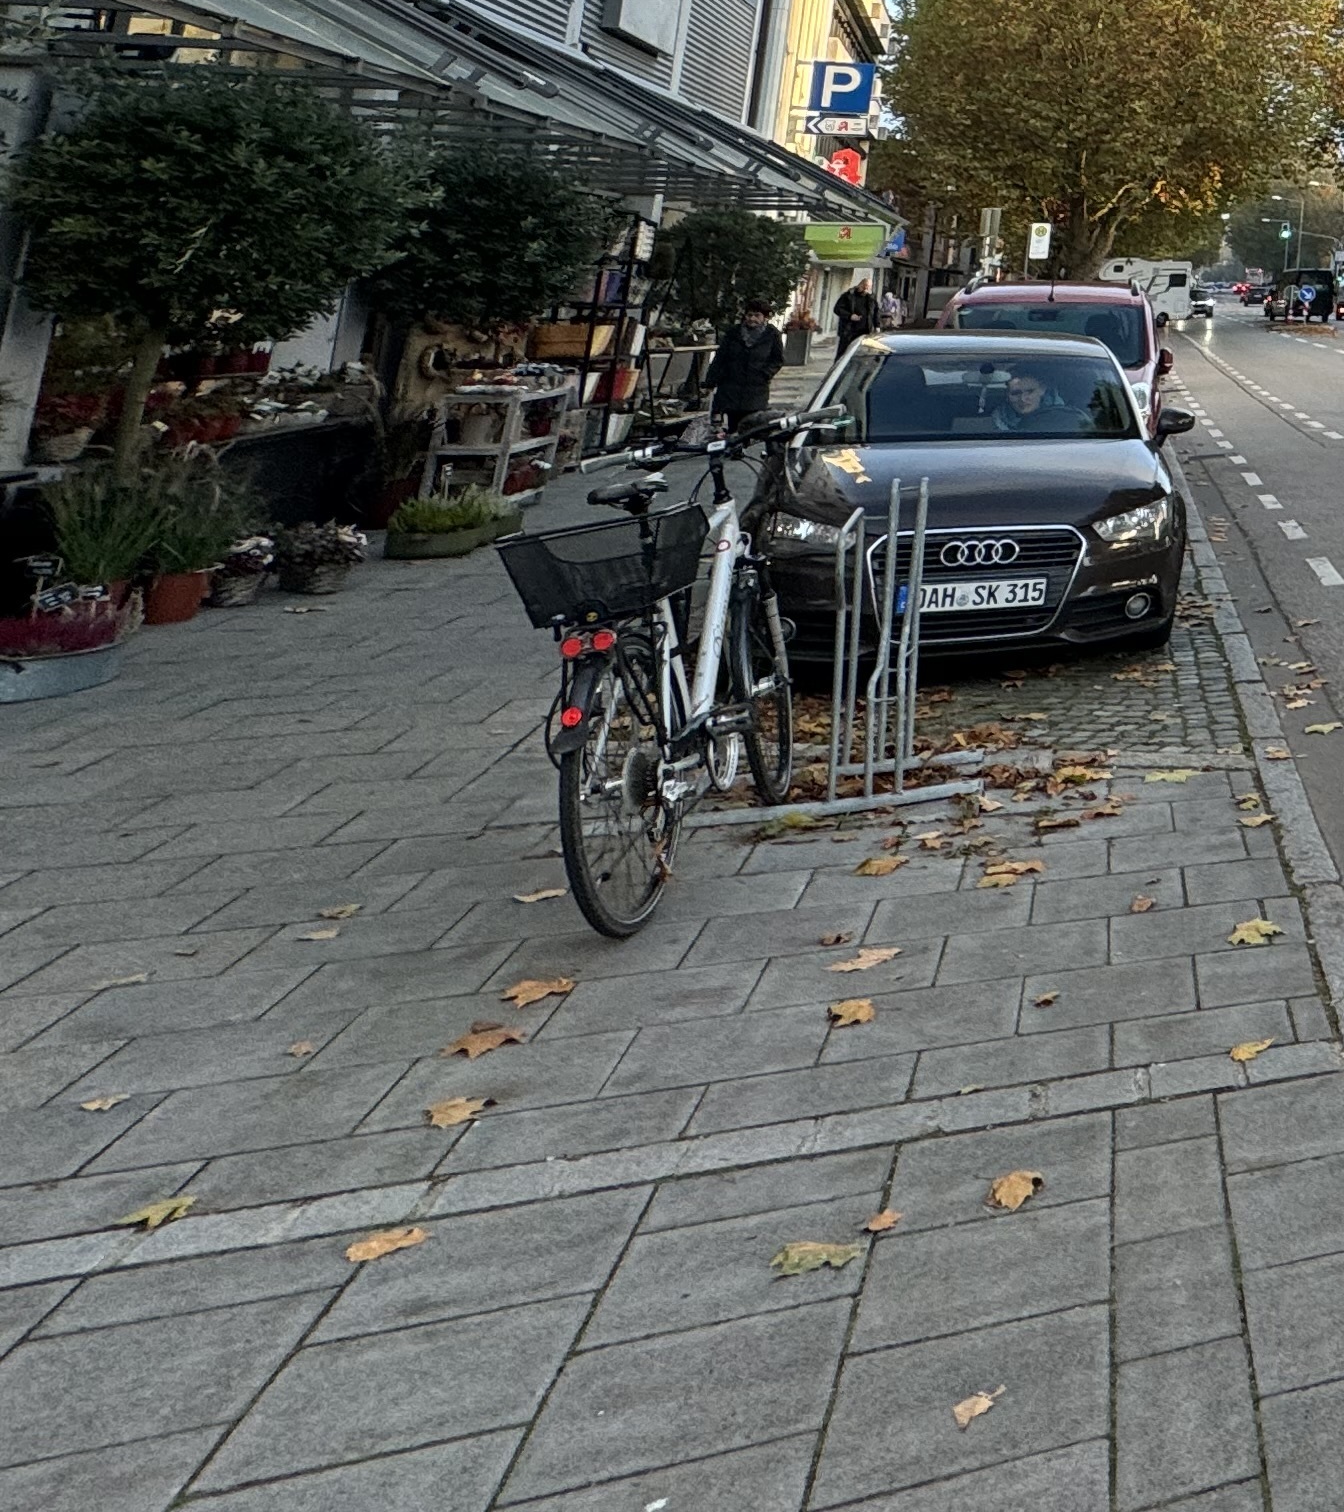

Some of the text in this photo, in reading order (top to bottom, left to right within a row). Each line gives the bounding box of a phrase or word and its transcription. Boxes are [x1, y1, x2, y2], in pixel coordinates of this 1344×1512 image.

[821, 65, 861, 108] P
[972, 584, 1000, 607] SK
[1004, 582, 1045, 604] 315
